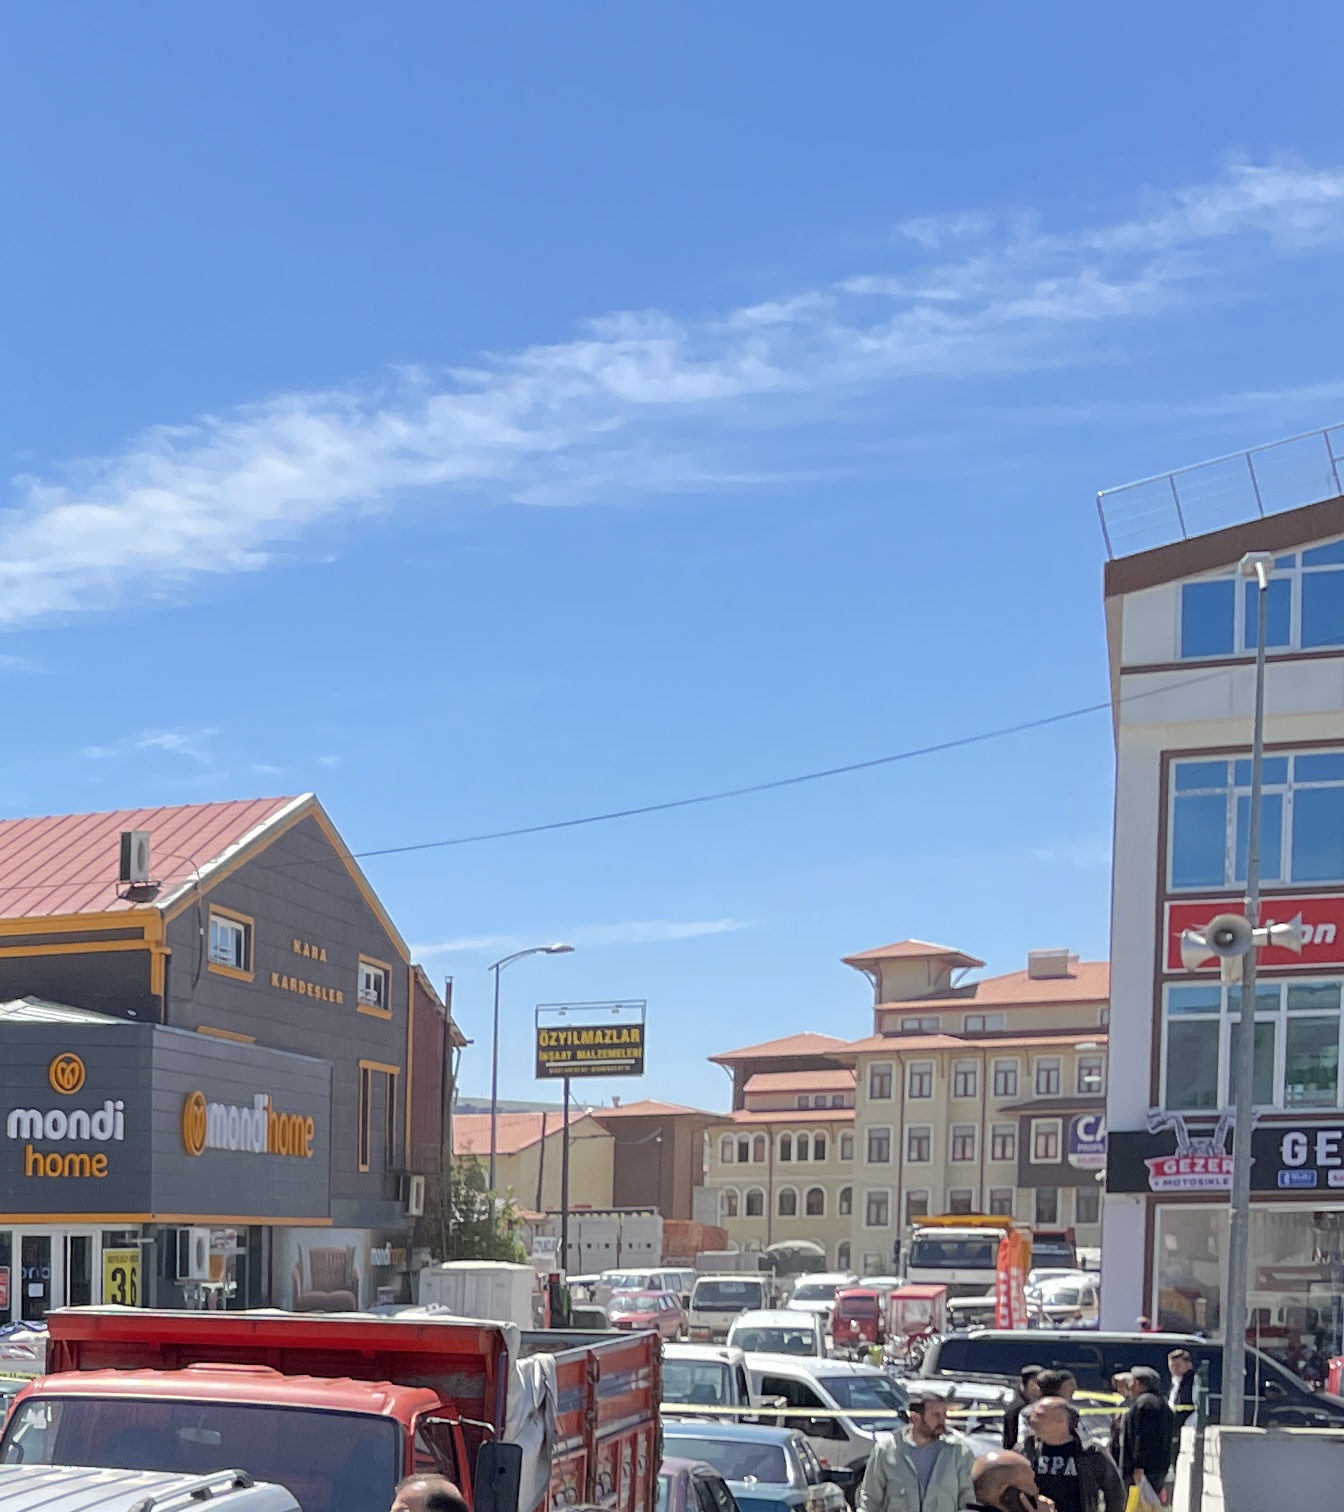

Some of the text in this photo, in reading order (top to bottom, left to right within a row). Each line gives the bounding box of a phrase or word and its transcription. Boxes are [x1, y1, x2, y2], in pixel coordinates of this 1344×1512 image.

[6, 1099, 125, 1141] mondi
[25, 1144, 109, 1178] home
[1163, 1157, 1234, 1175] GEZER
[1281, 1131, 1343, 1168] GE
[1163, 1176, 1230, 1187] MOTOSİKLE
